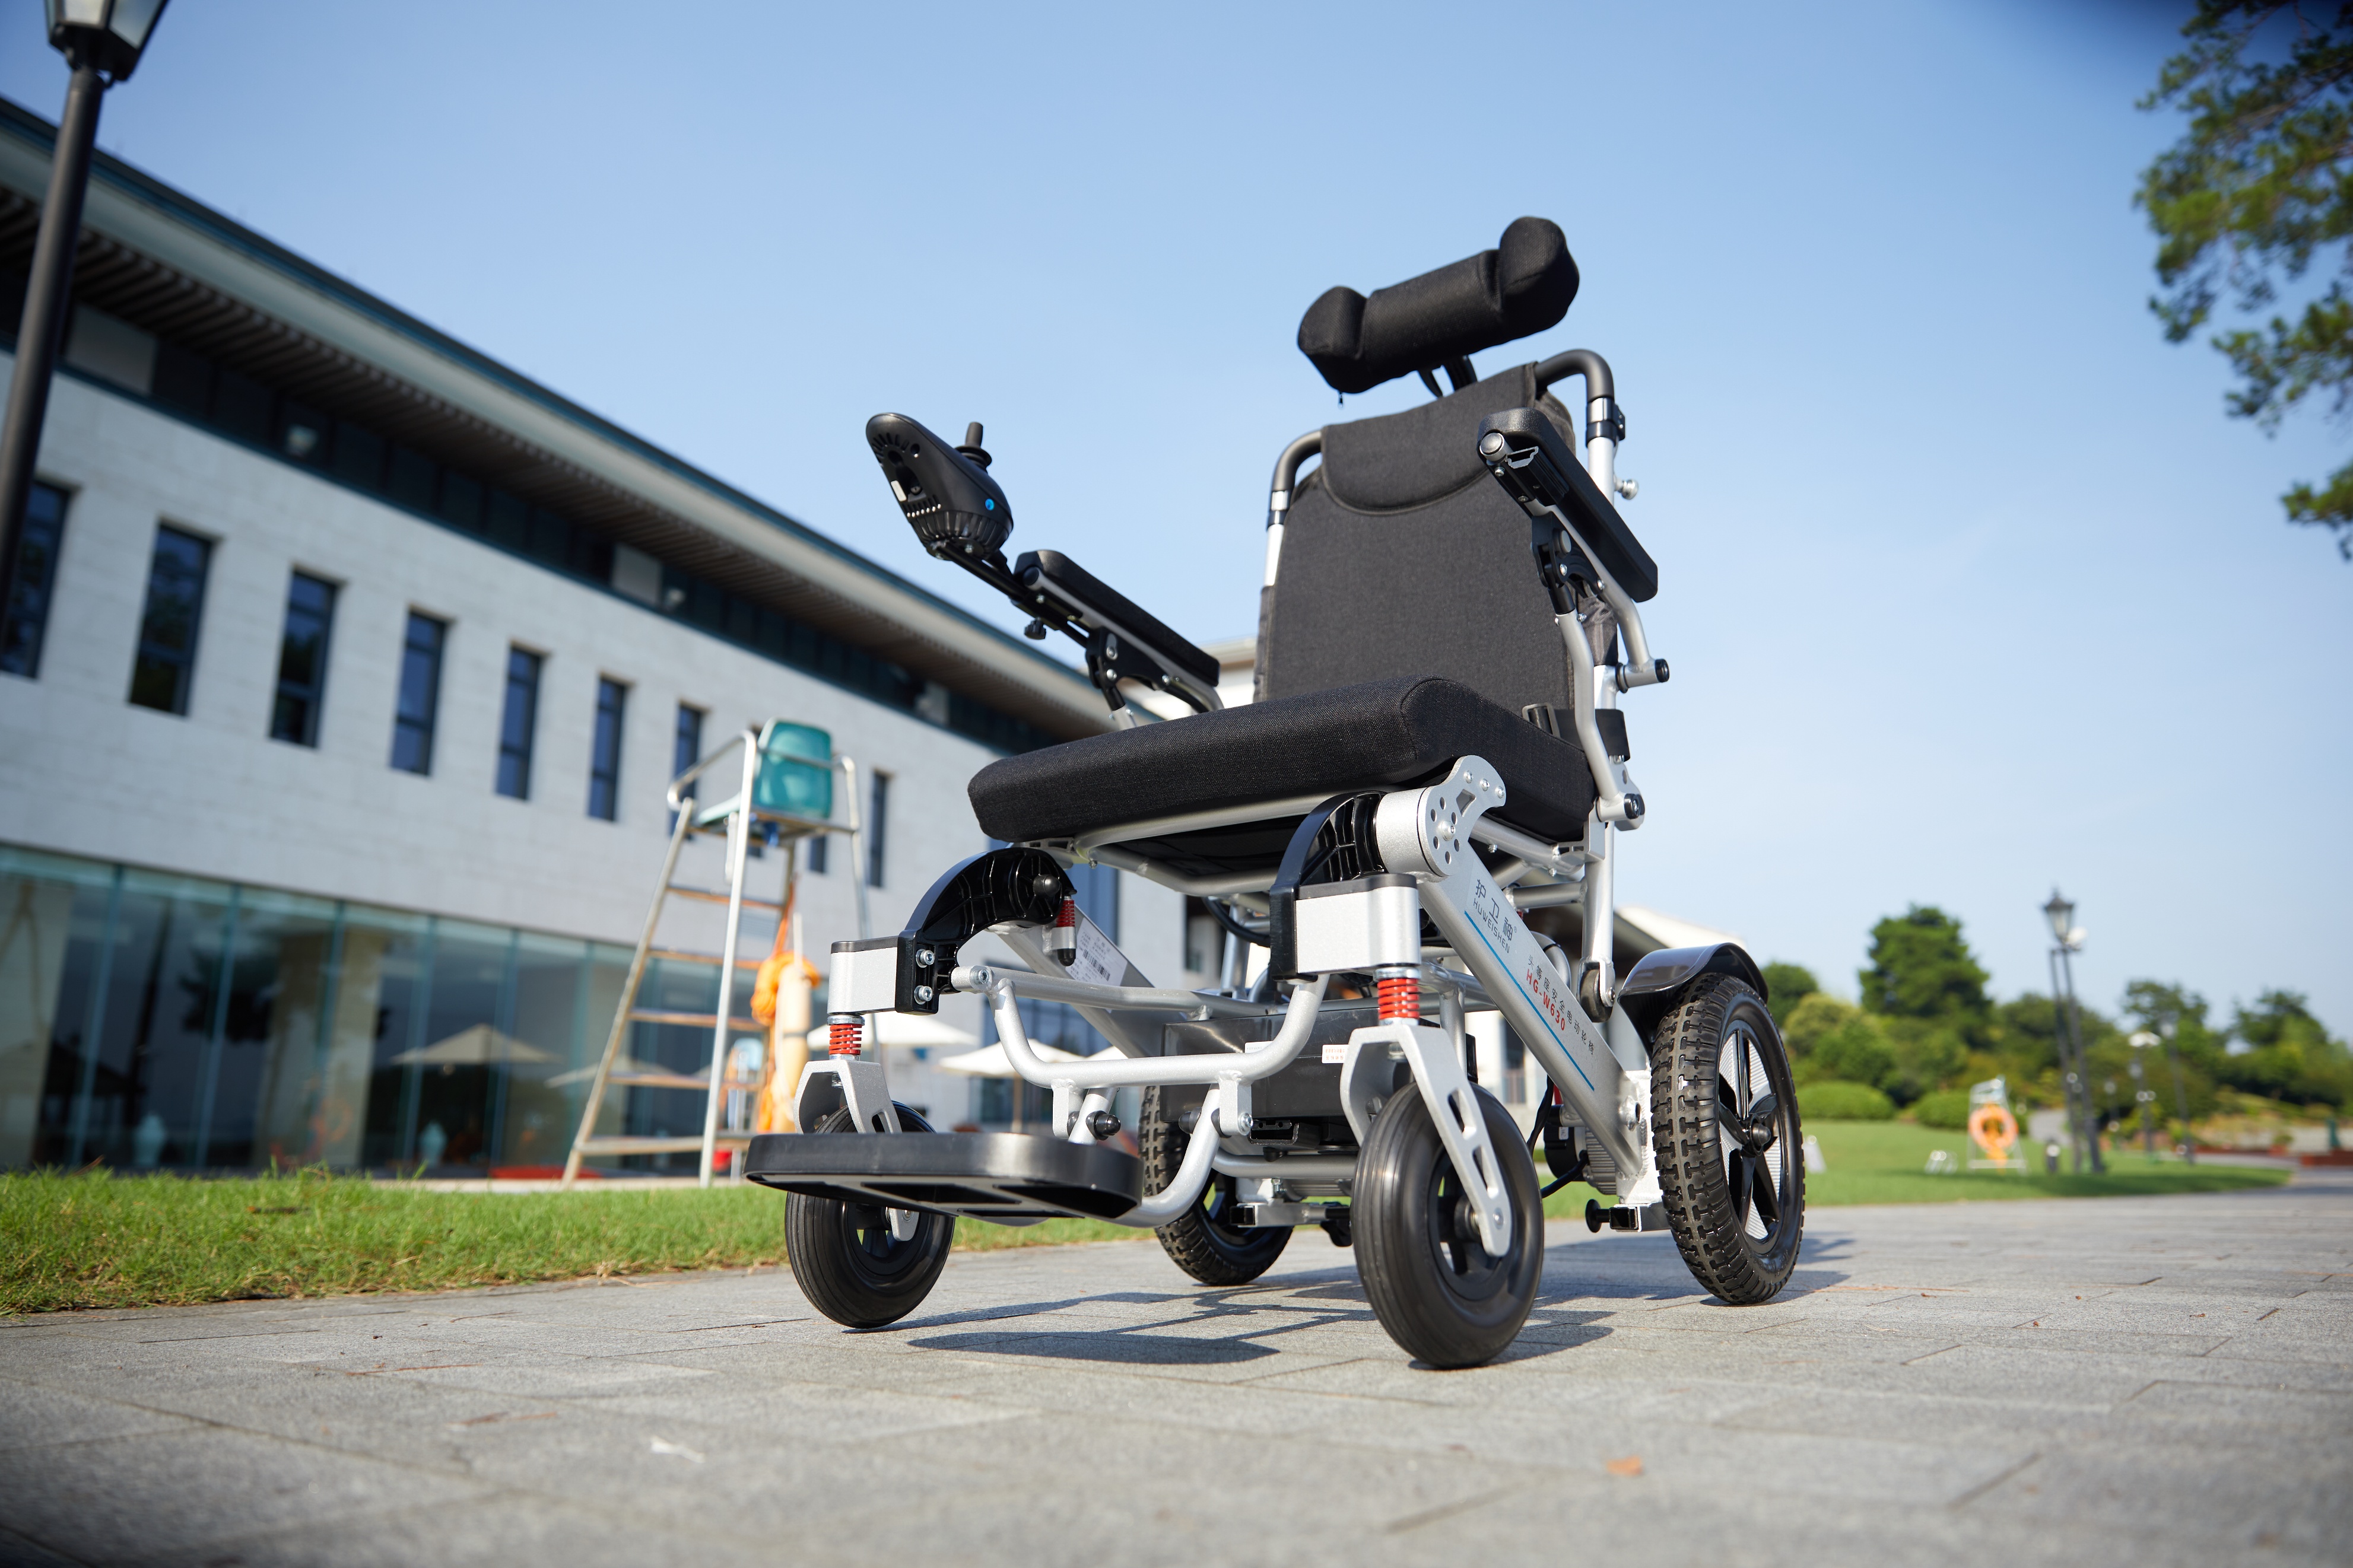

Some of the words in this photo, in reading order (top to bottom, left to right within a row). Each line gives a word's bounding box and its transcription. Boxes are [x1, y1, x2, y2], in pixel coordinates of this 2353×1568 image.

[1473, 898, 1510, 954] HUWEISHEN
[1475, 879, 1514, 942] 护卫神
[1526, 969, 1566, 1031] HG-W630
[1528, 954, 1595, 1055] 头等座安全电动轮椅
